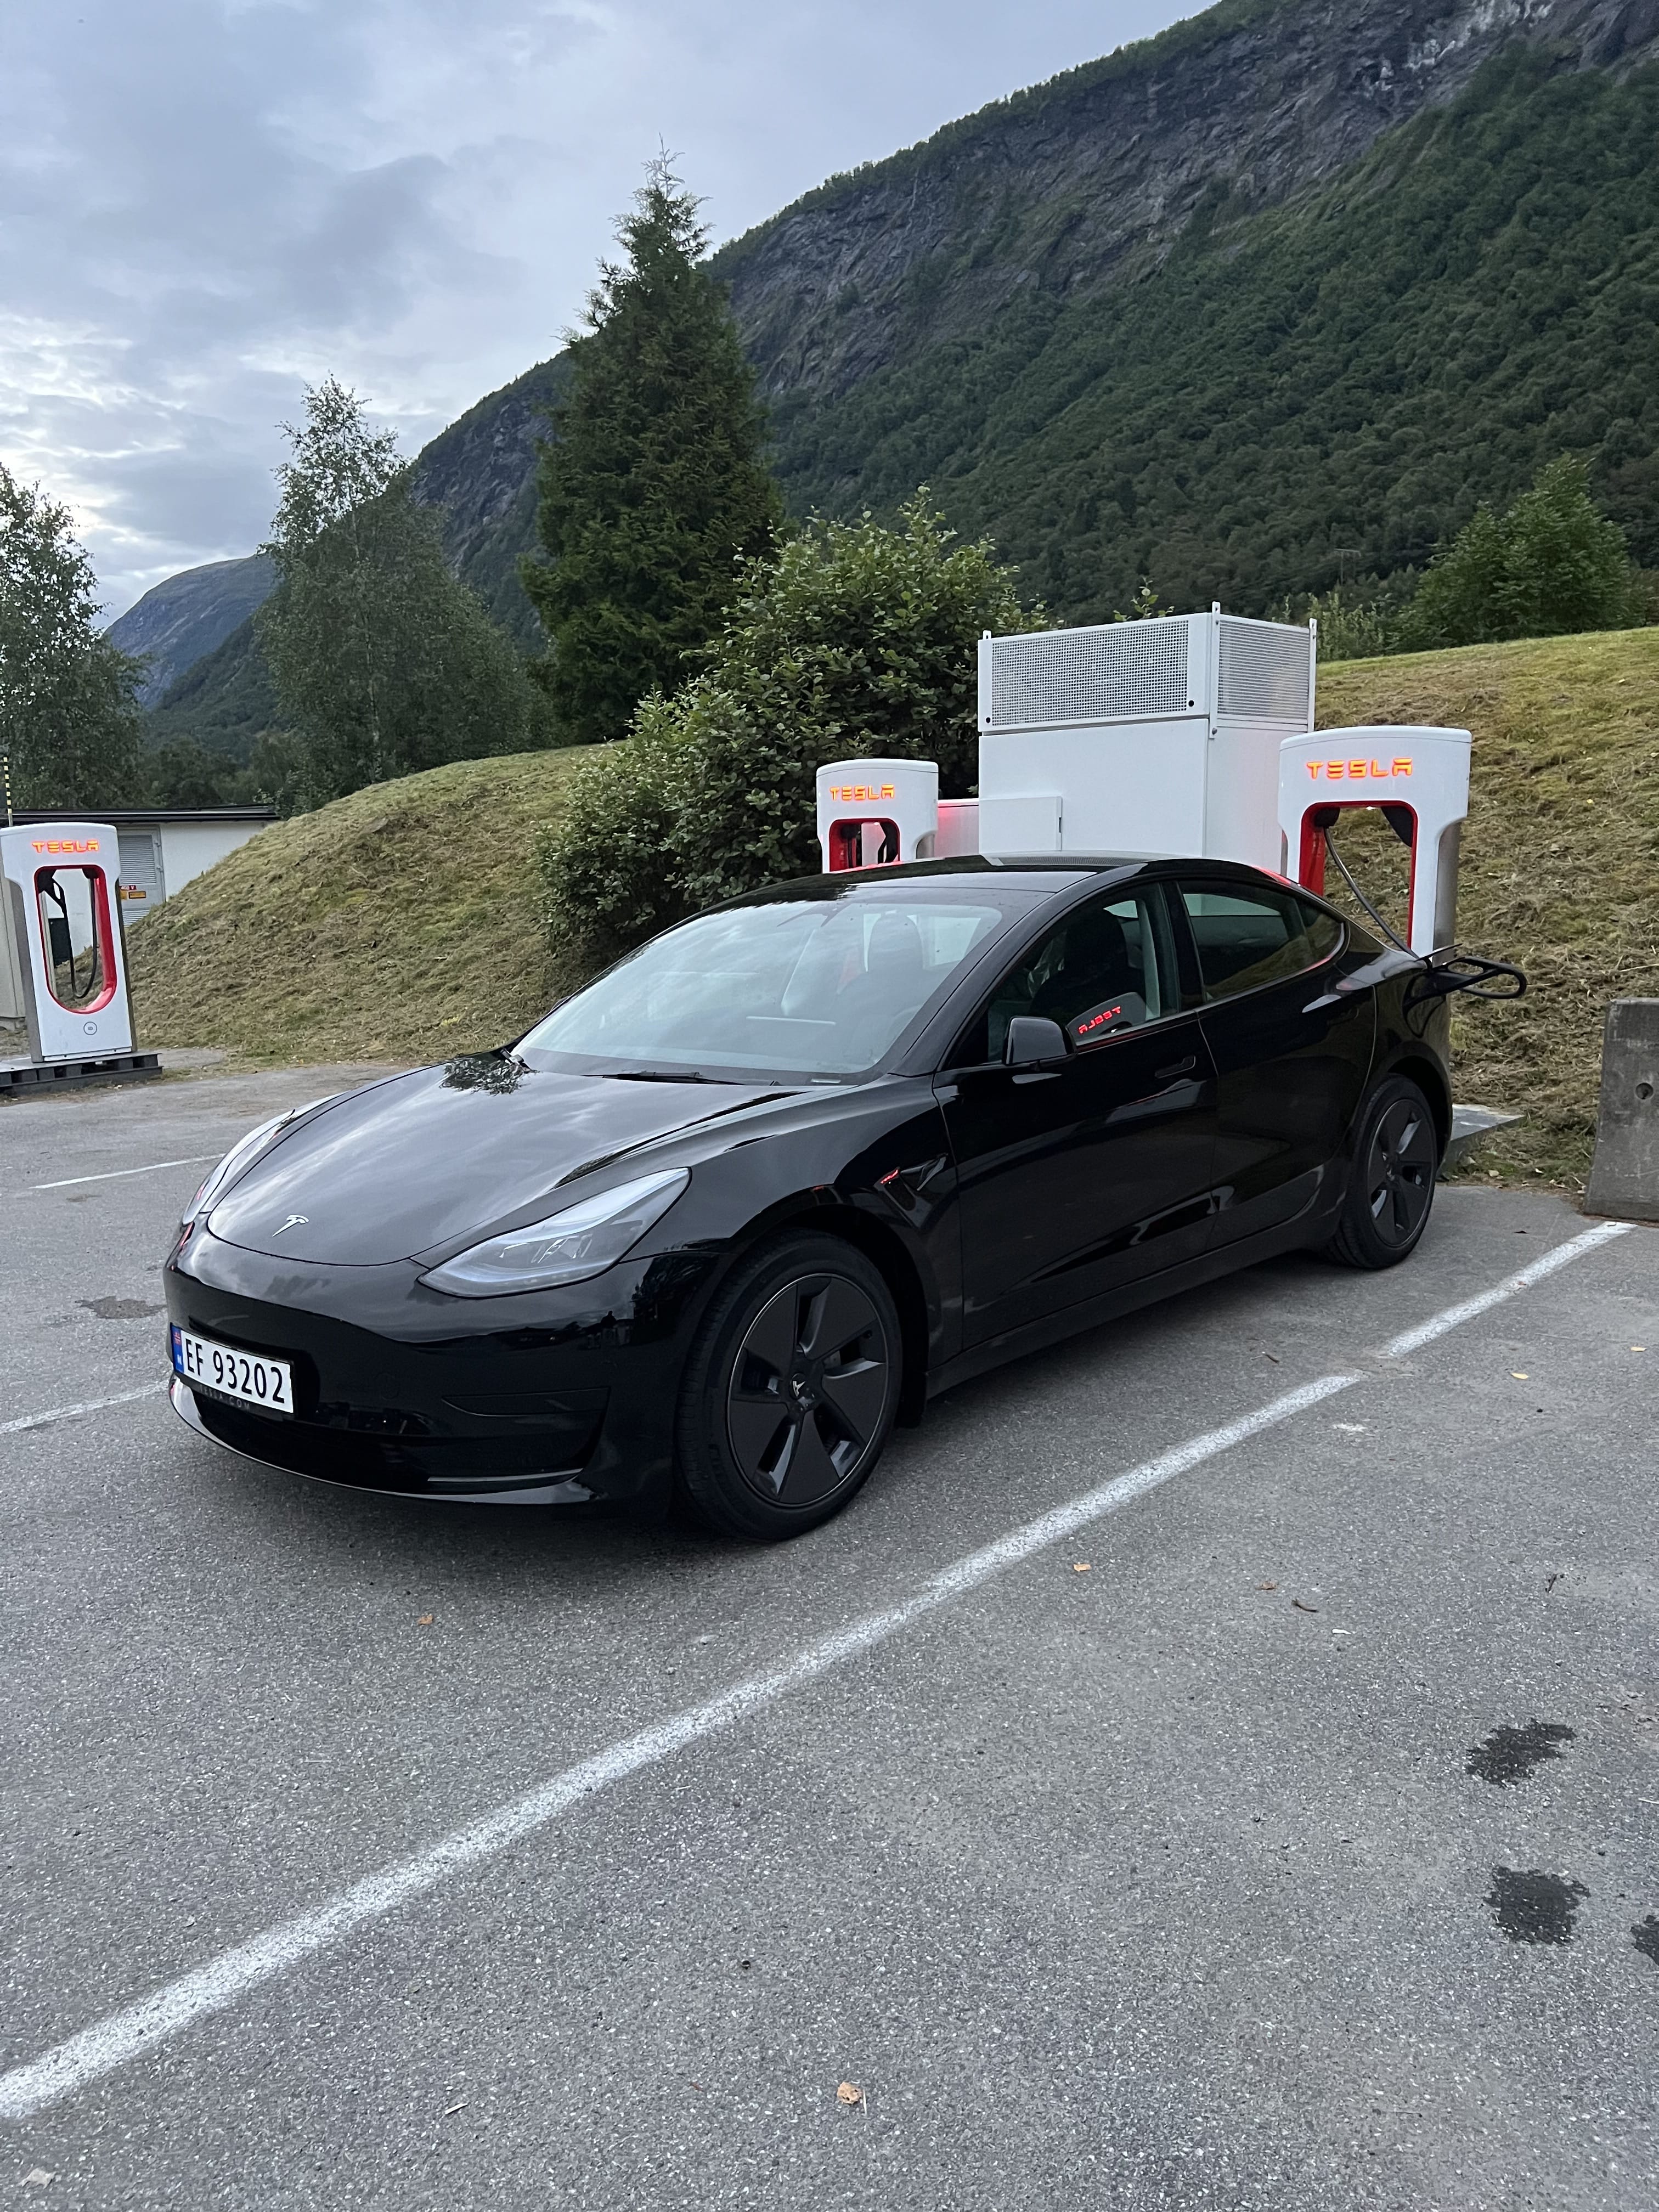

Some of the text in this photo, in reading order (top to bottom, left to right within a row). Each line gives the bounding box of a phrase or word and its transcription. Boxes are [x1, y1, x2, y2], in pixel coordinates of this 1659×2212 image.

[1306, 758, 1413, 779] TESLA
[830, 783, 895, 800] TESLA
[31, 839, 99, 853] TESLA
[185, 1338, 284, 1403] EF 93202
